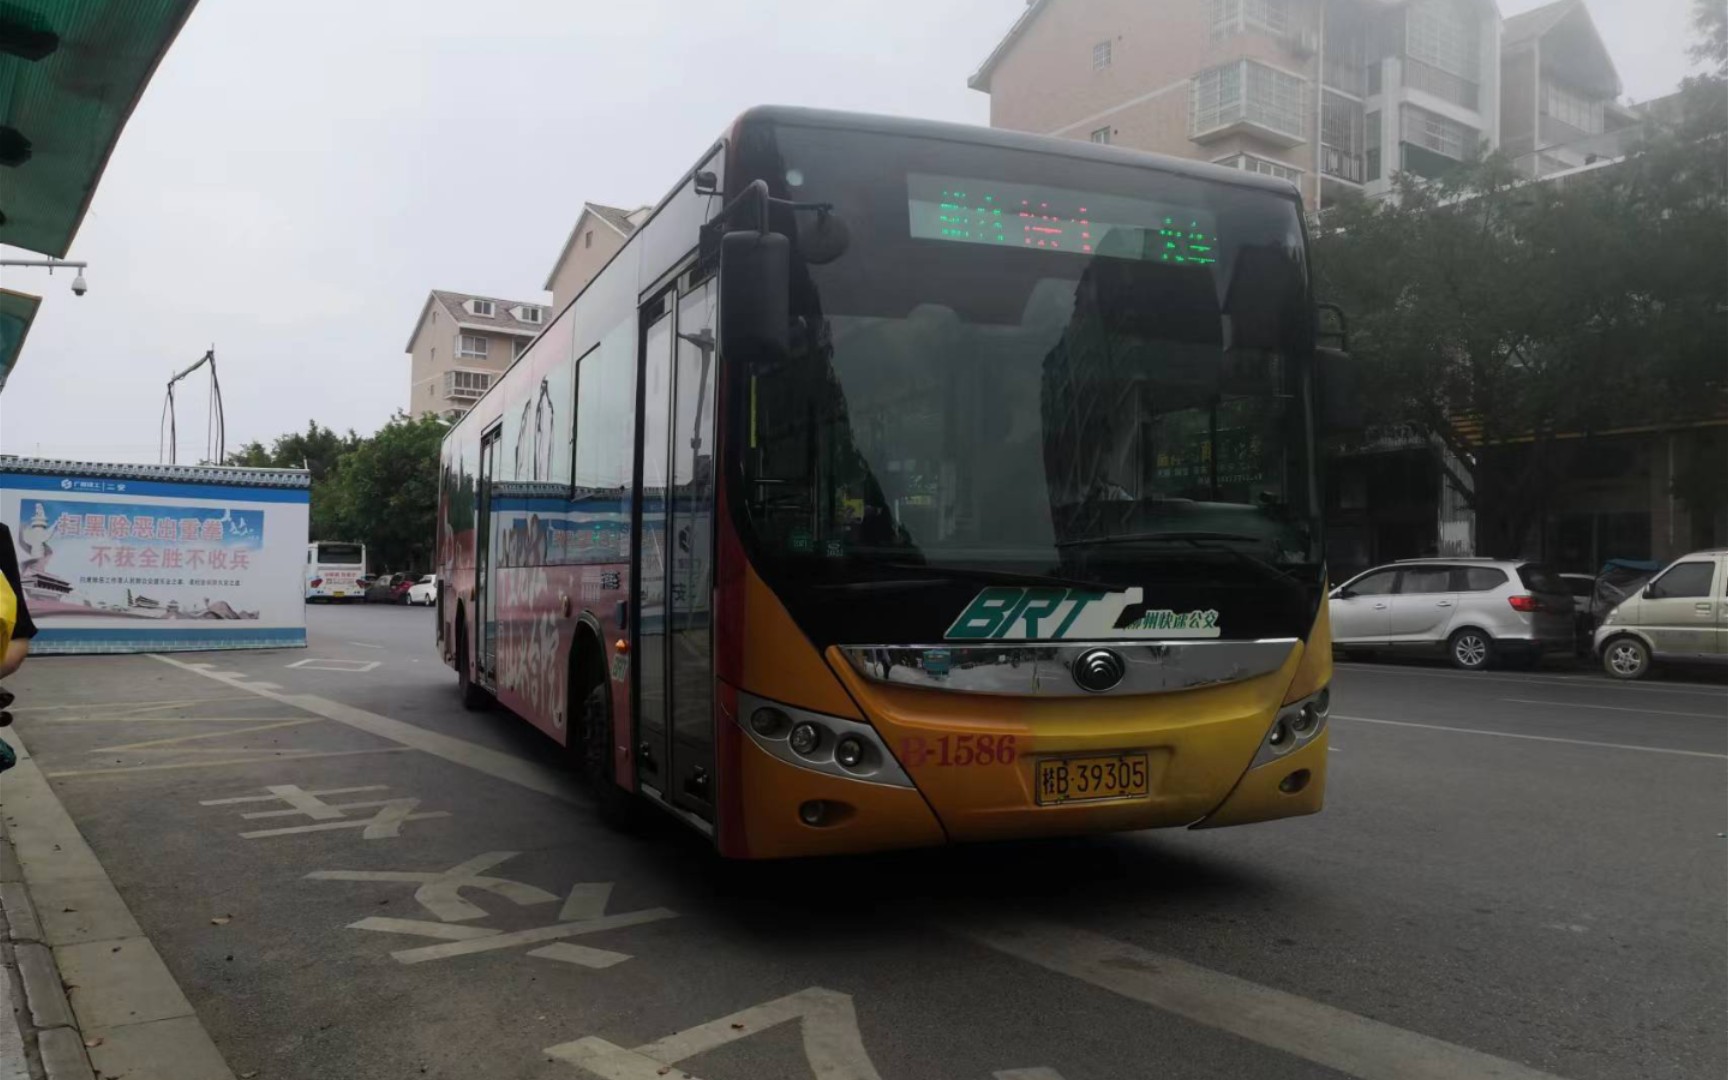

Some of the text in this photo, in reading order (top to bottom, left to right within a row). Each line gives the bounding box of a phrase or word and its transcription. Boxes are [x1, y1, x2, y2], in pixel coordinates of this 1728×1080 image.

[57, 513, 224, 541] 扫黑除恶出重拳
[90, 546, 250, 570] 不获全胜不收兵
[945, 587, 1106, 639] BRT
[901, 734, 1016, 767] B-1586
